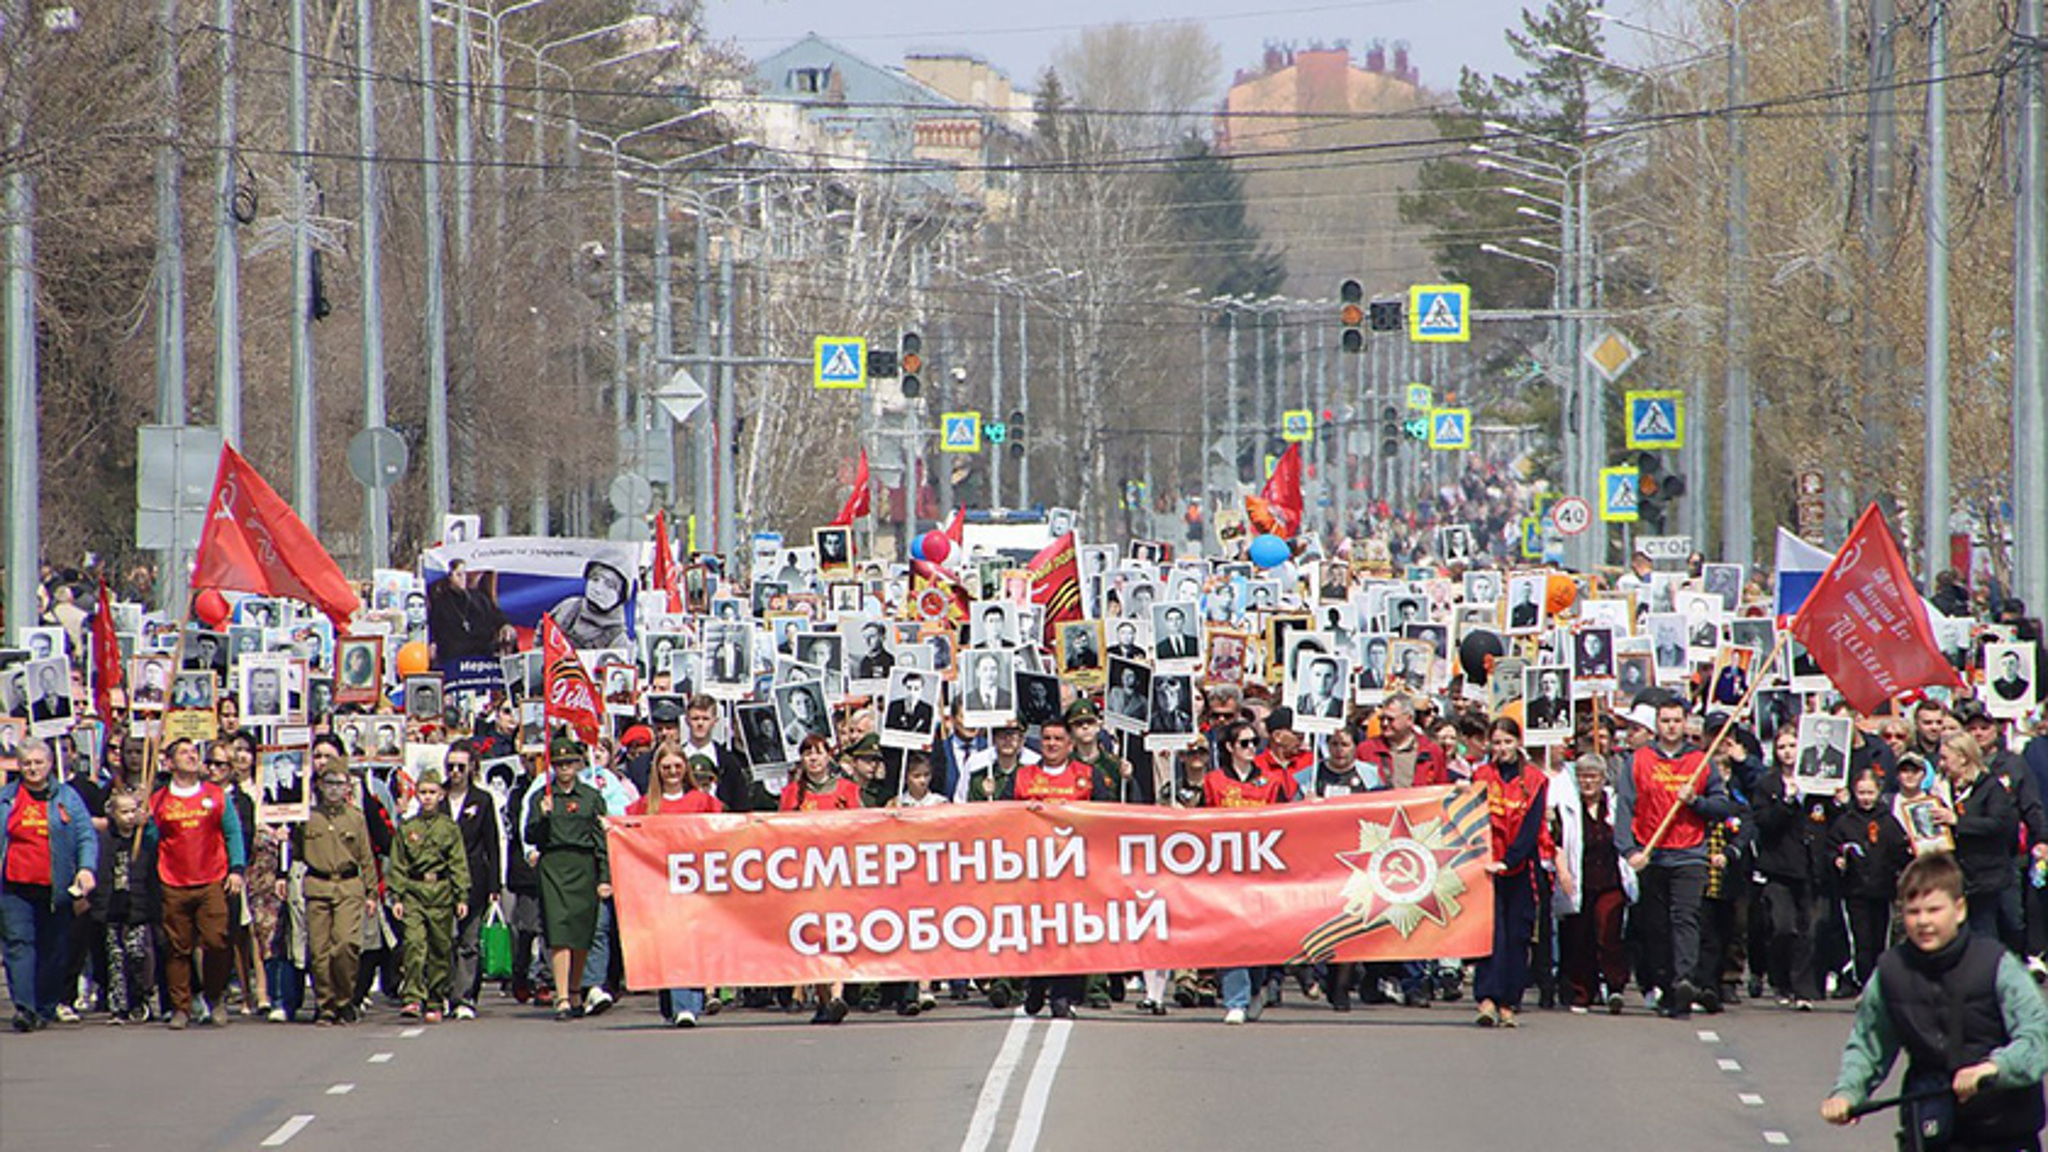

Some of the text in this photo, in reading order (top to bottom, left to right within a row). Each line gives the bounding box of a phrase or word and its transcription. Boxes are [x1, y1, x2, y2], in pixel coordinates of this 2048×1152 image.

[1559, 507, 1586, 523] 40
[667, 826, 1287, 894] БЕССМЕРТНЫЙ ПОЛК
[788, 888, 1169, 955] СВОБОДНЫЙ
